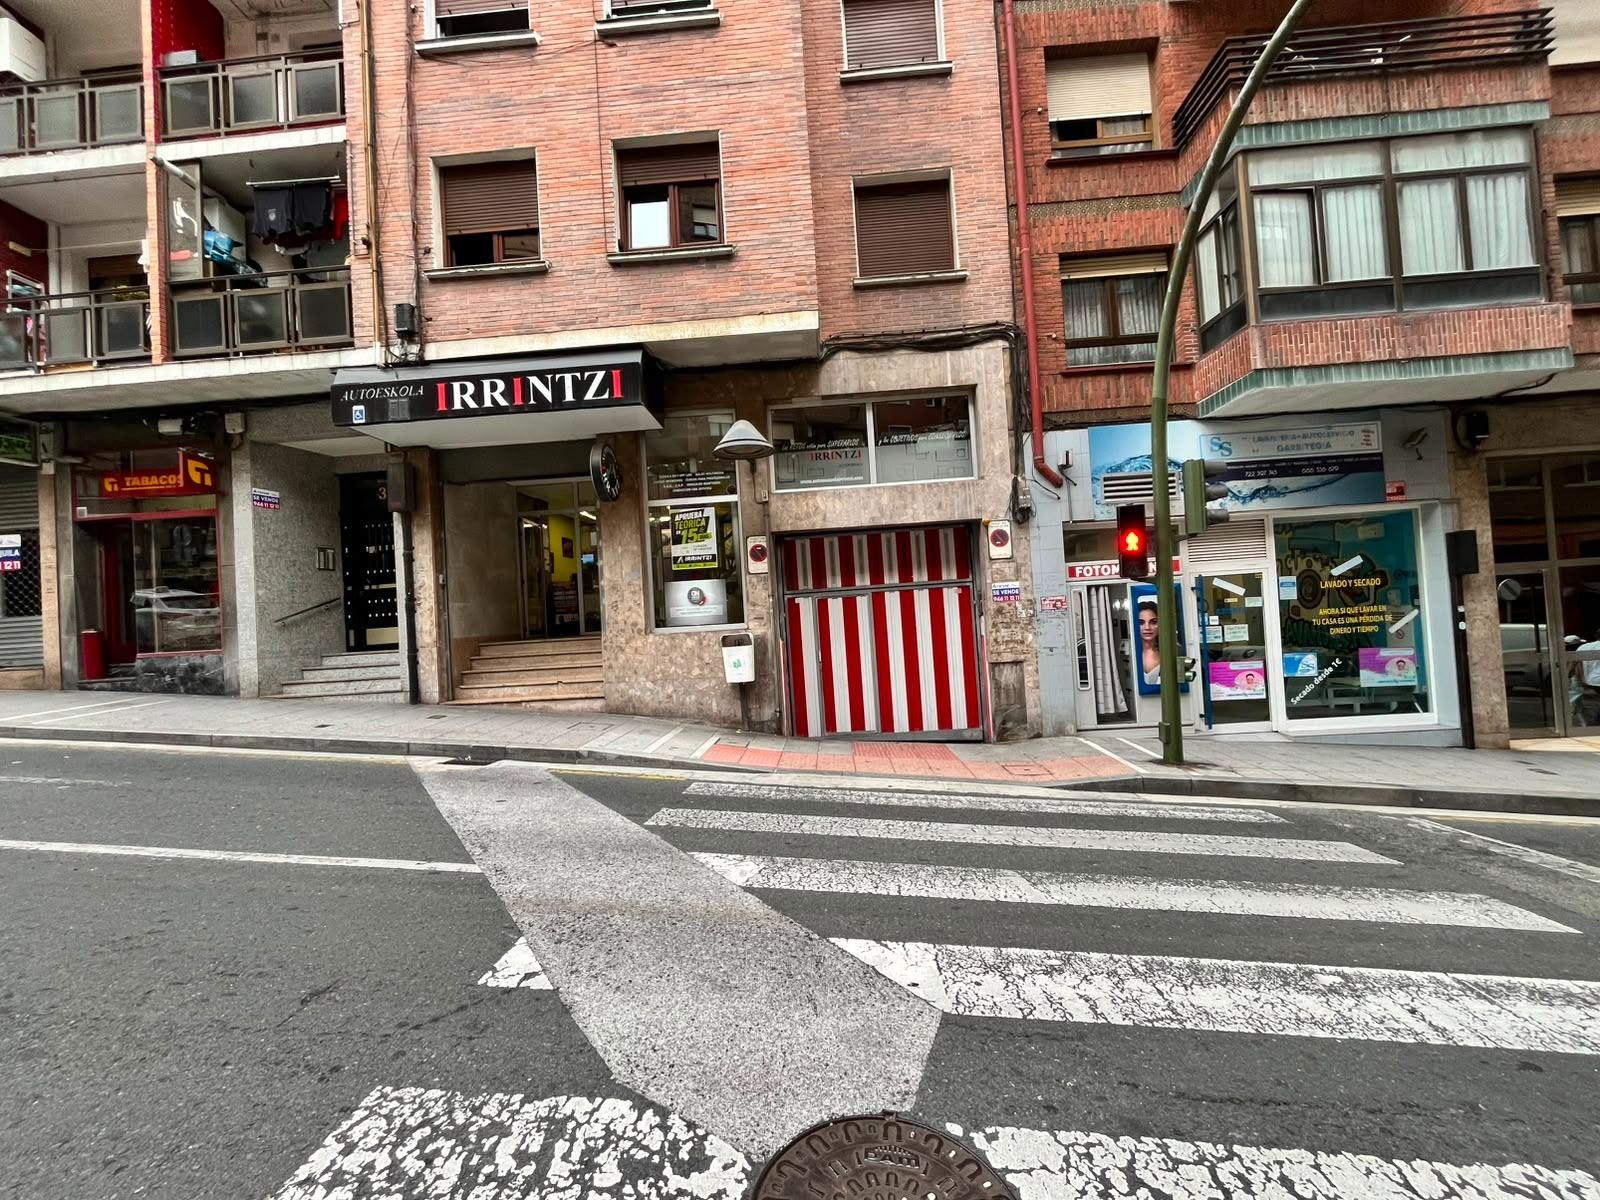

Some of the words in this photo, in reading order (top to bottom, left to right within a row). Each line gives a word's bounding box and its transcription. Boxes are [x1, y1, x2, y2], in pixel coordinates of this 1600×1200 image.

[340, 385, 424, 401] AUTOESKOLA
[436, 369, 624, 412] IRRINTZI
[810, 449, 862, 461] IRRINTZI
[682, 528, 698, 544] 15
[1320, 580, 1348, 588] LAVADO
[1354, 578, 1381, 586] SECADO
[1290, 684, 1315, 705] Secado
[1314, 667, 1334, 684] desde
[1332, 658, 1342, 668] 1€
